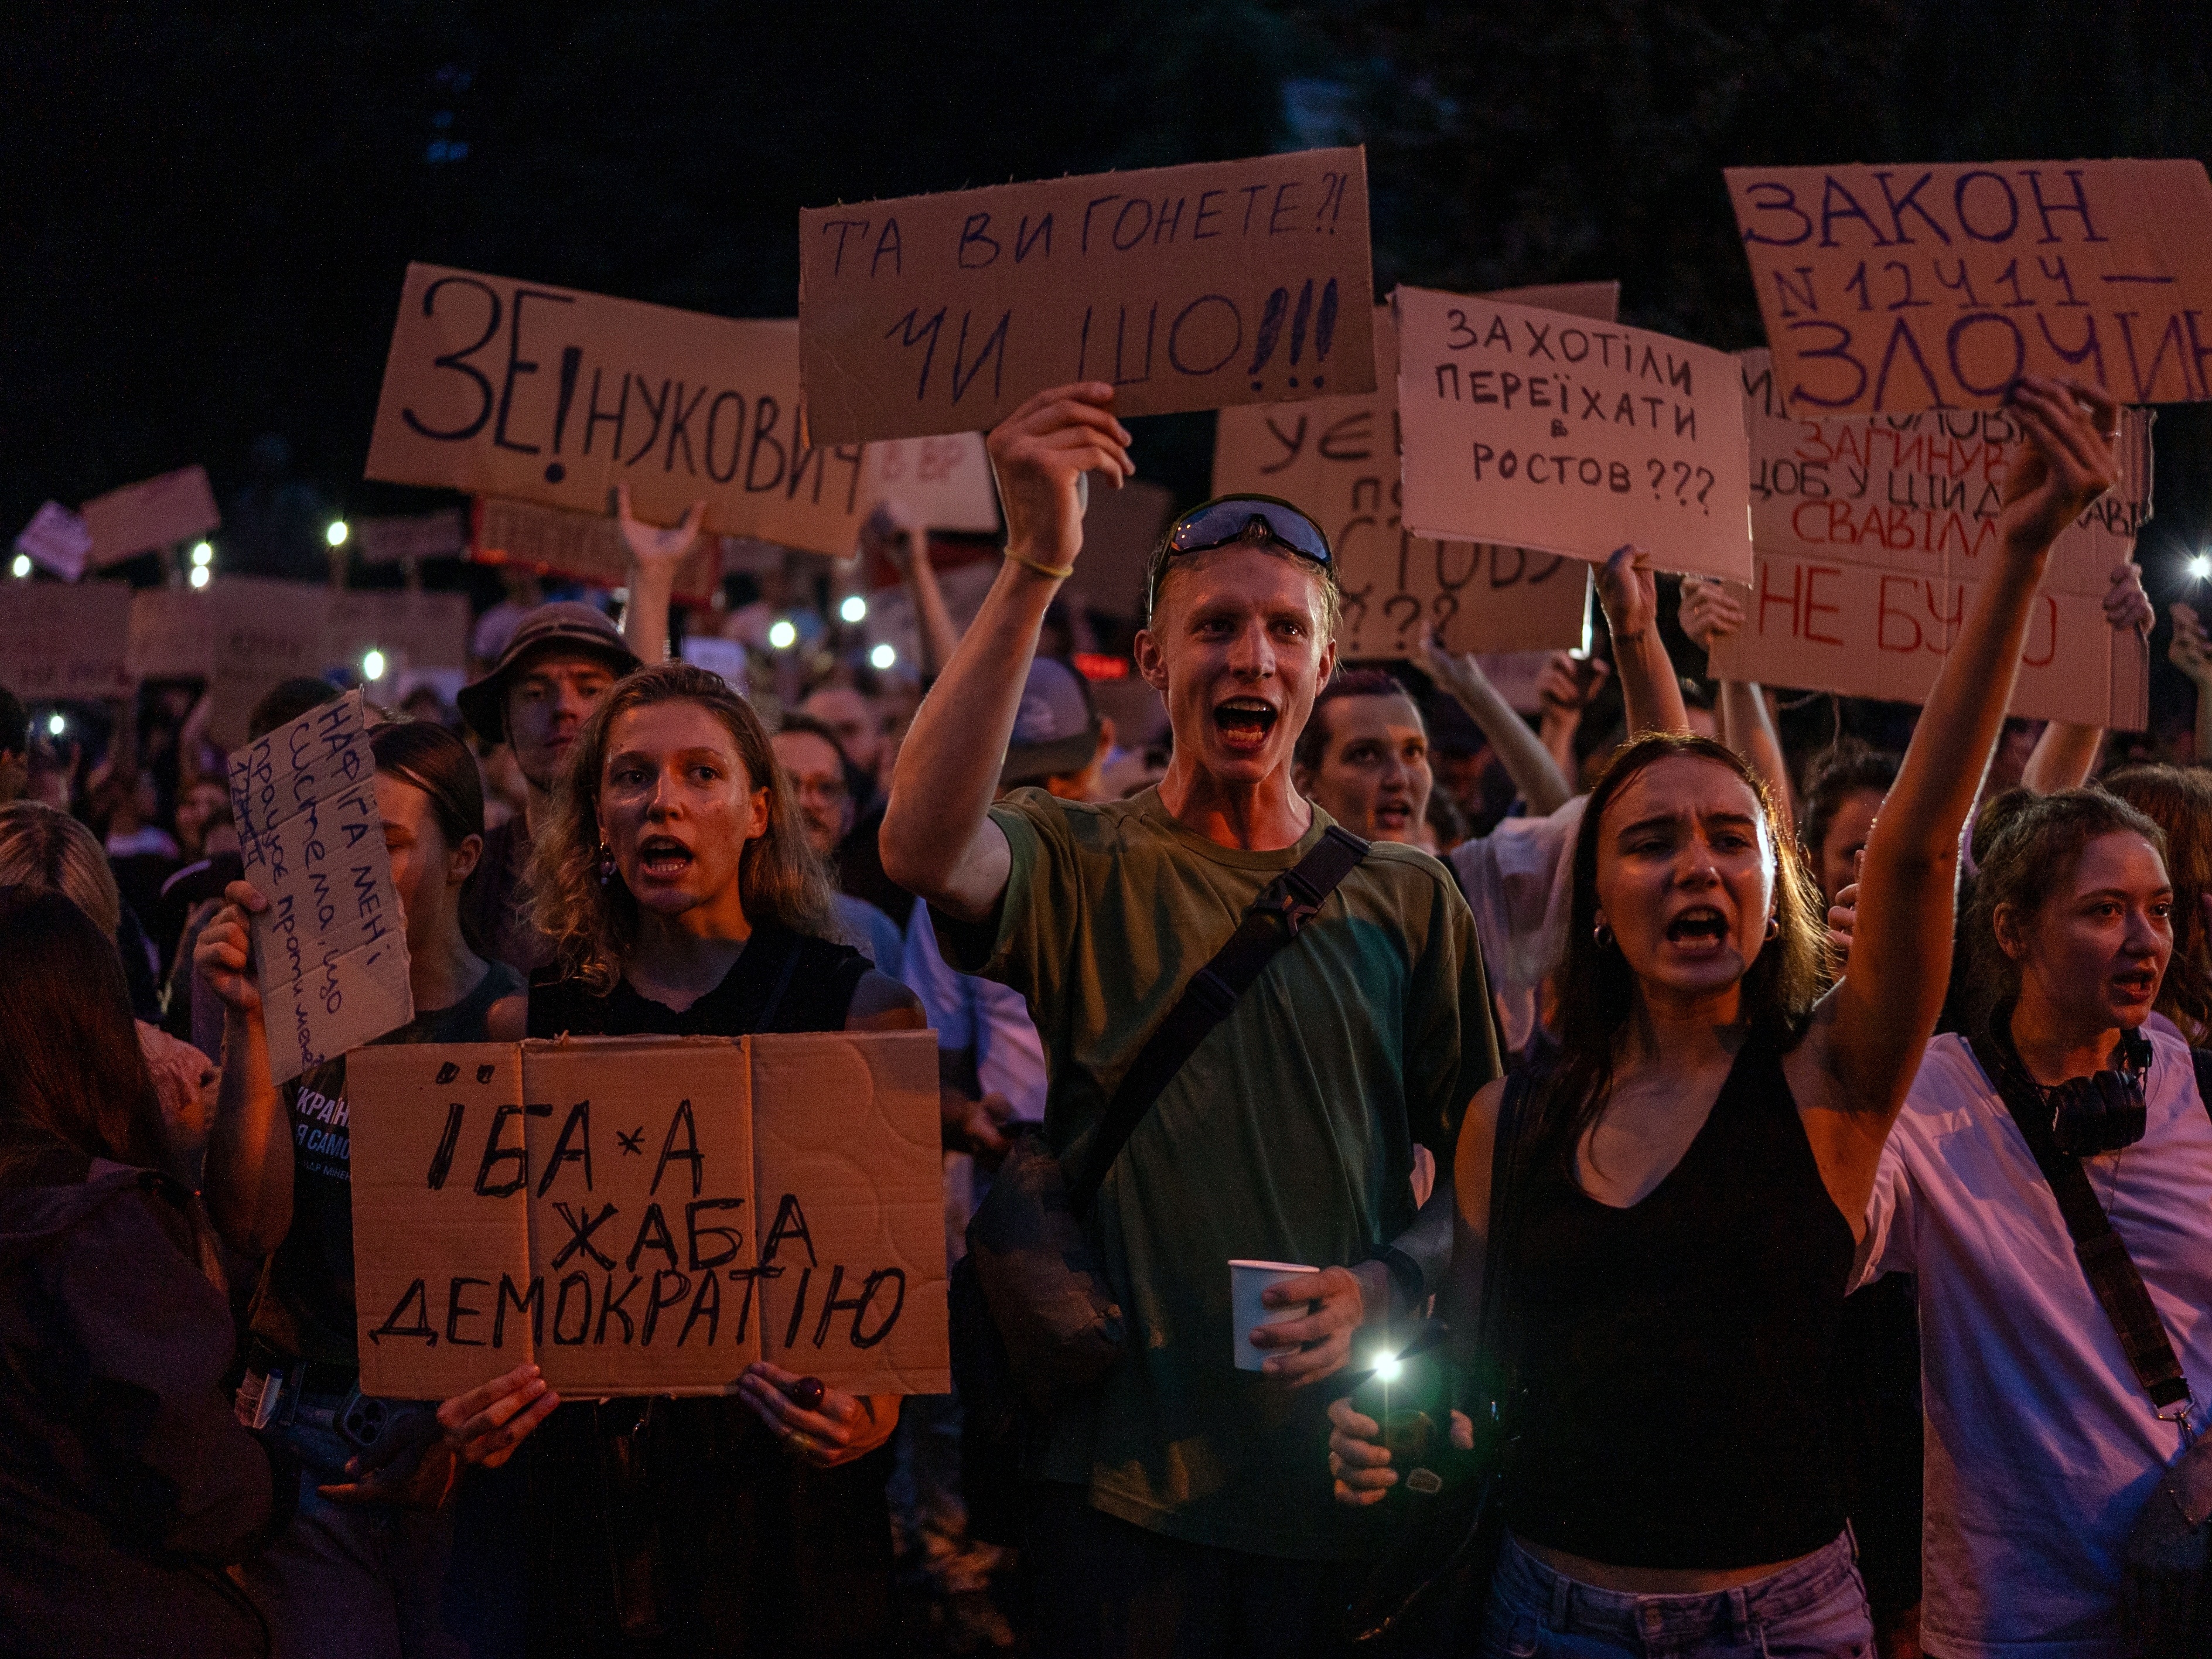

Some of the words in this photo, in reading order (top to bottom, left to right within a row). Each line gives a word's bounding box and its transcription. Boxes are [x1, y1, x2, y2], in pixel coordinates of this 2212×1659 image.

[824, 218, 902, 277] ТА
[1743, 169, 2109, 248] ЗАКОН
[885, 306, 1012, 406] ЧИ
[1077, 277, 1338, 392] ШО!!!
[1435, 362, 1696, 442] ПЕРЕЇХАТИ
[1759, 561, 1844, 648] НЕ
[551, 1193, 817, 1271] ЖАБА
[368, 1264, 906, 1349] ДЕМОКРАТІЮ
